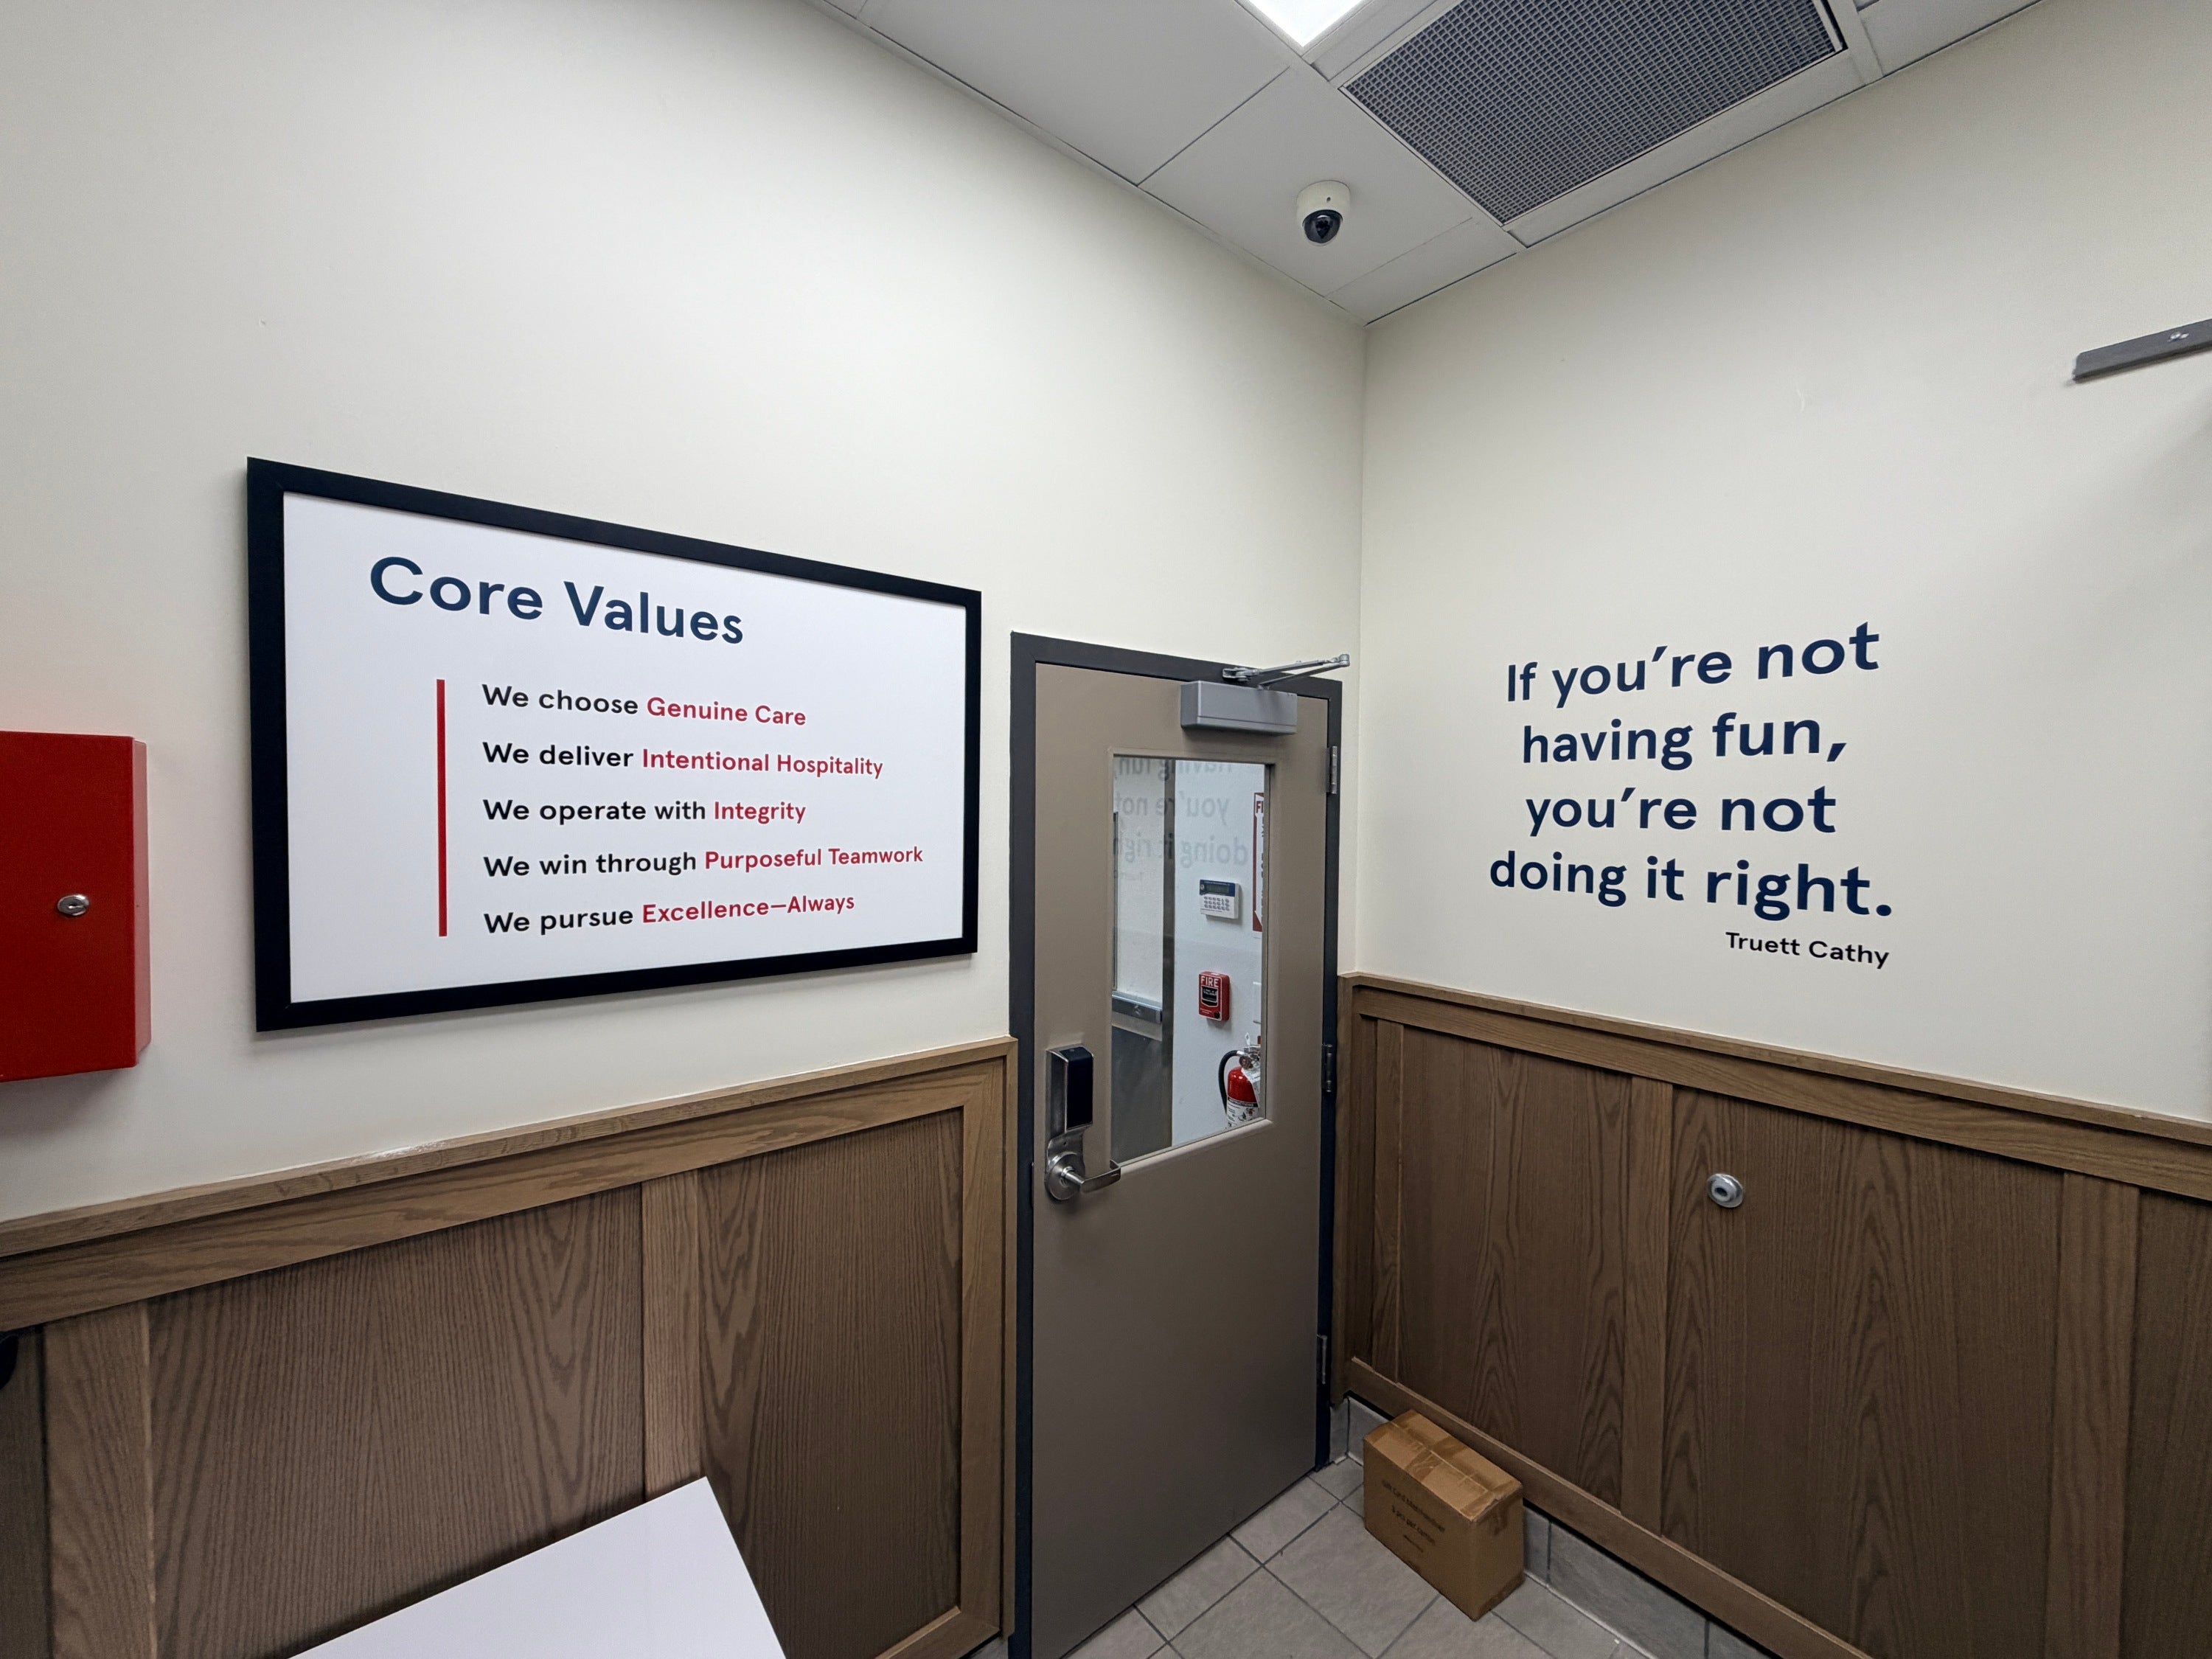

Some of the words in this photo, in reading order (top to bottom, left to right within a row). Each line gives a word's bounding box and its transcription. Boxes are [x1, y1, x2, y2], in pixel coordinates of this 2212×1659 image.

[370, 556, 543, 620] Core
[563, 581, 743, 644] Values
[1508, 661, 1538, 702] If
[1552, 645, 1732, 709] you're
[1758, 622, 1879, 680] not
[481, 684, 529, 708] We
[538, 689, 639, 714] choose
[647, 697, 748, 722] Genuine
[755, 705, 806, 726] Care
[482, 742, 529, 764] We
[539, 744, 634, 767] deliver
[643, 748, 769, 771] Intentional
[777, 754, 883, 779] Hospitality
[1523, 718, 1694, 771] having
[1712, 712, 1847, 762] fun,
[482, 799, 529, 821] We
[539, 801, 647, 826] operate
[654, 801, 706, 820] with
[714, 801, 806, 824] Integrity
[1526, 787, 1697, 837] you're
[1721, 785, 1836, 833] not
[483, 855, 530, 877] We
[539, 859, 587, 875] win
[595, 852, 696, 876] through
[706, 848, 821, 873] Purposeful
[828, 846, 923, 865] Teamwork
[1490, 850, 1627, 908] doing
[1646, 855, 1685, 901] it
[1707, 859, 1892, 922] right.
[483, 911, 530, 933] We
[540, 910, 633, 936] pursue
[1725, 931, 1801, 956] Truett
[1809, 940, 1890, 970] Cathy
[1200, 975, 1219, 988] FIRE
